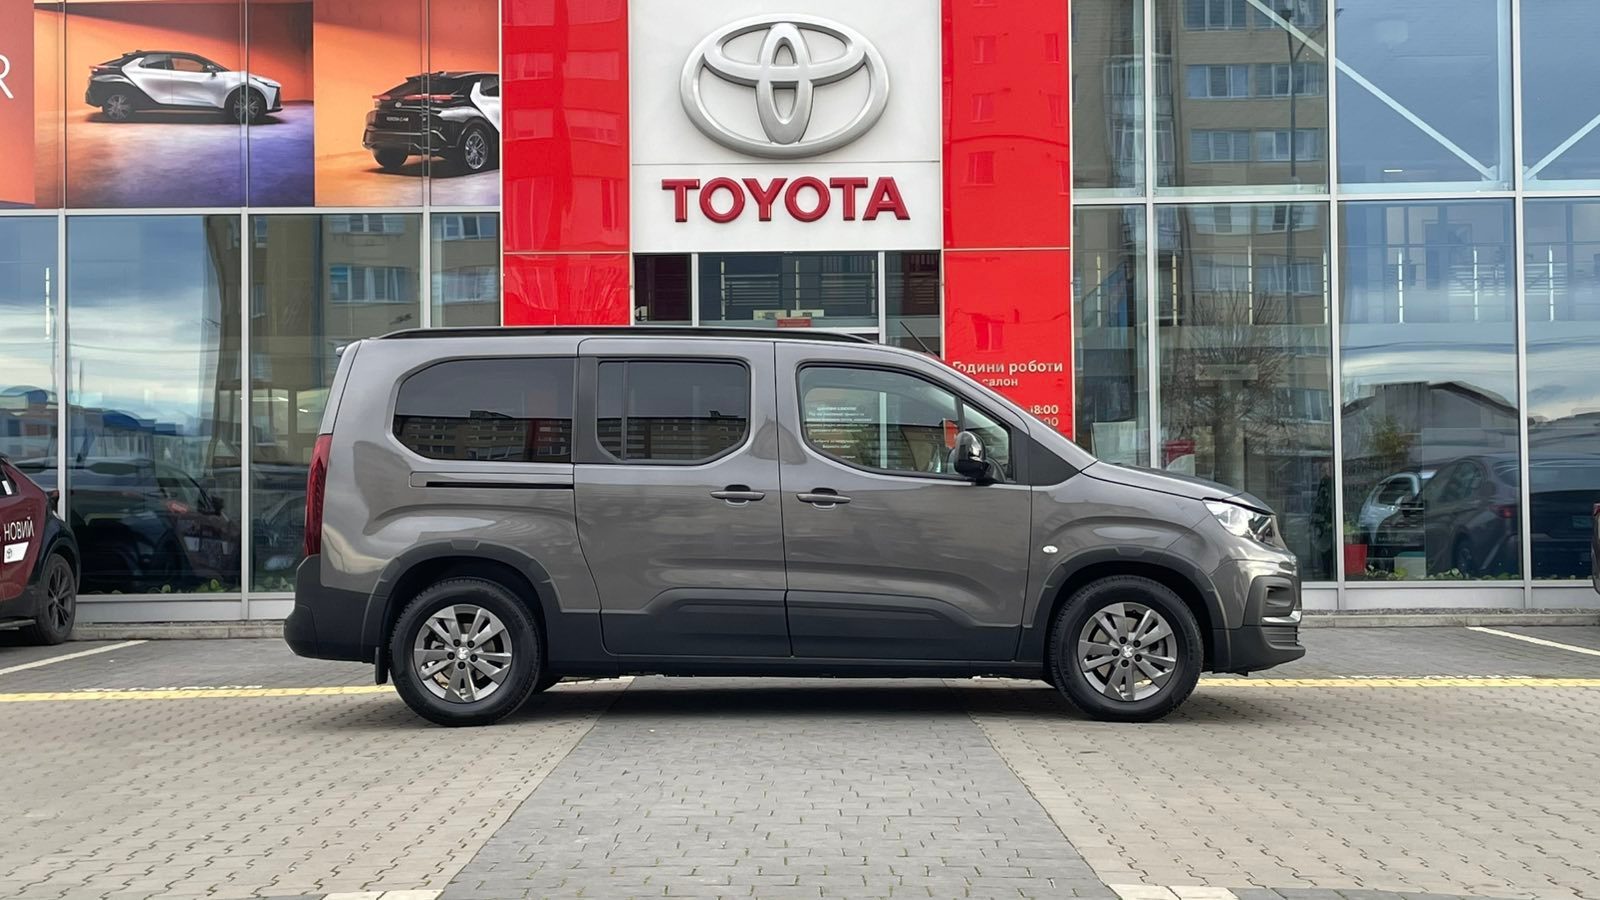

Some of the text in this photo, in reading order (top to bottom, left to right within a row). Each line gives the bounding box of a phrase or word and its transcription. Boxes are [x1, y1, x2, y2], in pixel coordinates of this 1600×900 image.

[661, 176, 911, 223] TOYOTA
[1009, 360, 1062, 375] роботи
[4, 516, 34, 541] НОВИЙ
